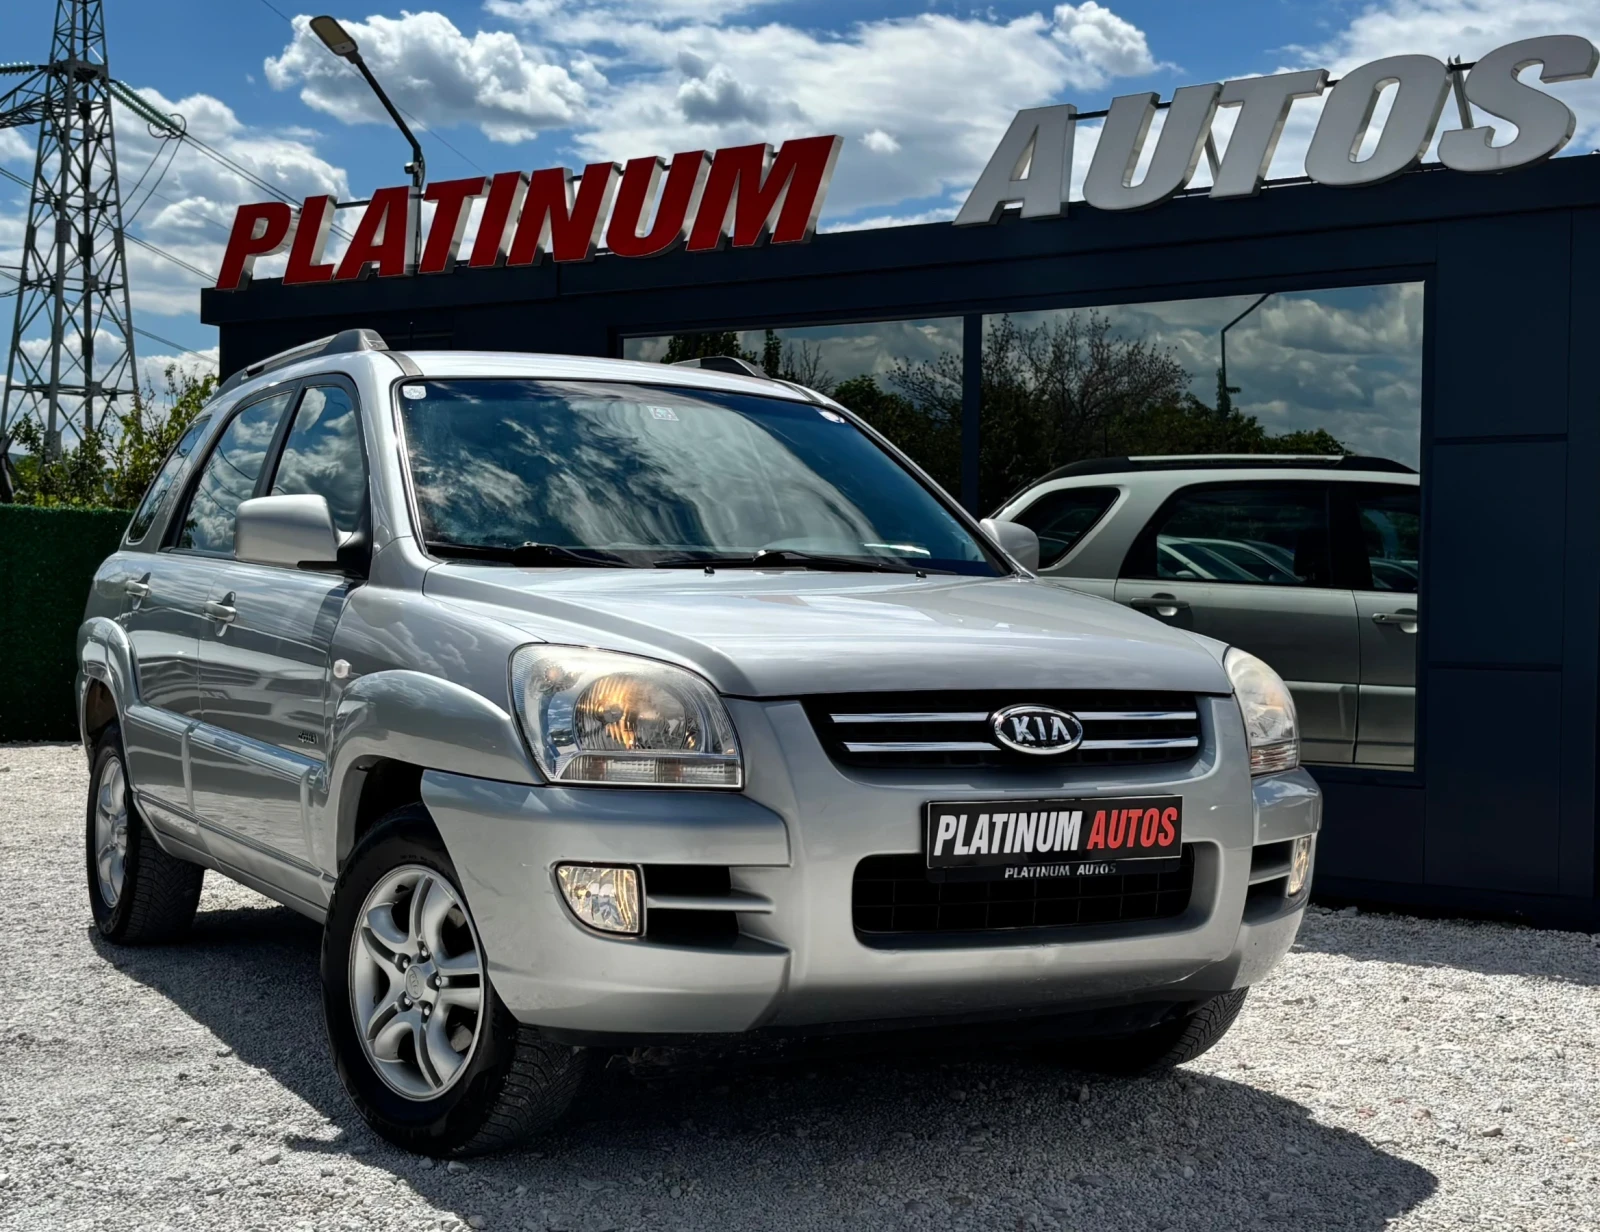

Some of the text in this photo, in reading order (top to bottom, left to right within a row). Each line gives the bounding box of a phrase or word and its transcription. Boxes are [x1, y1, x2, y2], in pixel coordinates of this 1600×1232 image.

[215, 35, 1599, 290] PLATINUM AUTOS
[1010, 716, 1070, 742] KIA
[933, 807, 1178, 856] PLATINUM AUTOS
[1005, 863, 1116, 878] PLATINUM AUTOS
